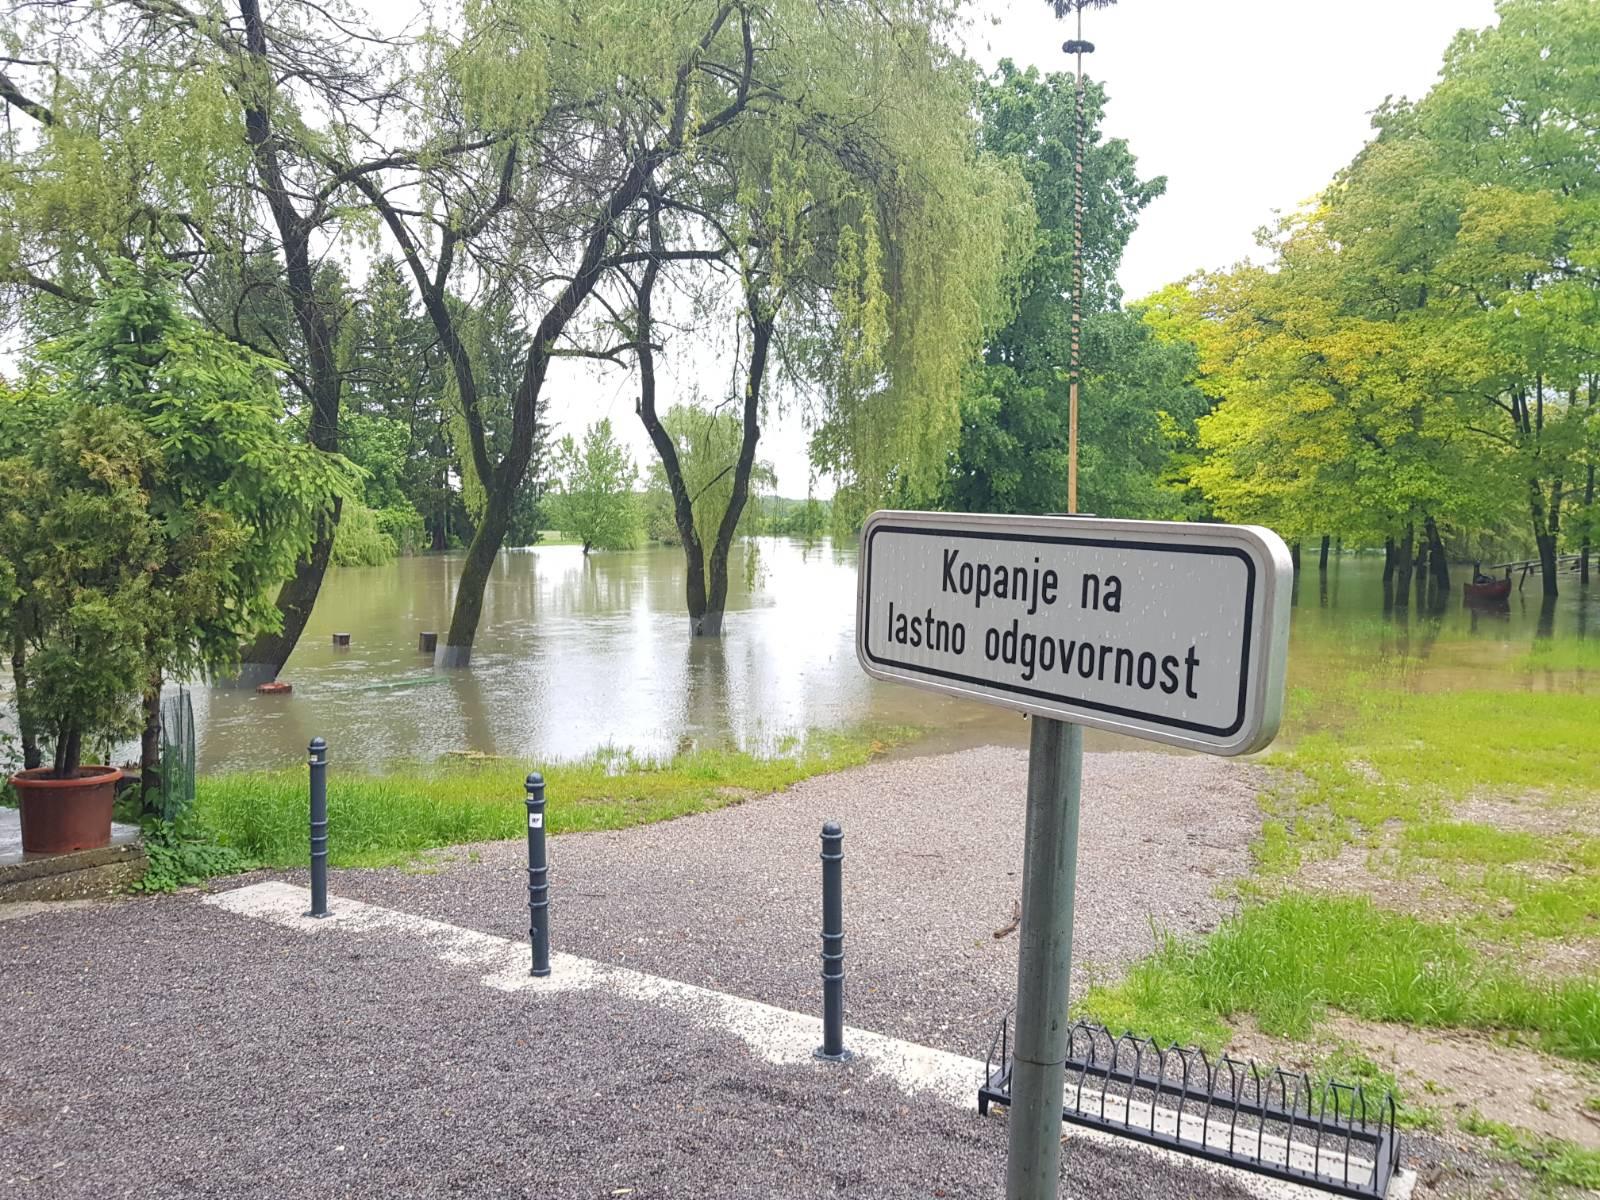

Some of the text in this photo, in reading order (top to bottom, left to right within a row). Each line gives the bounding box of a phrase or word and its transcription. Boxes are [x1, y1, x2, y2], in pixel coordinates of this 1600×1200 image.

[942, 549, 1121, 615] Kopanje na
[888, 602, 1200, 699] lastno odgovornost
